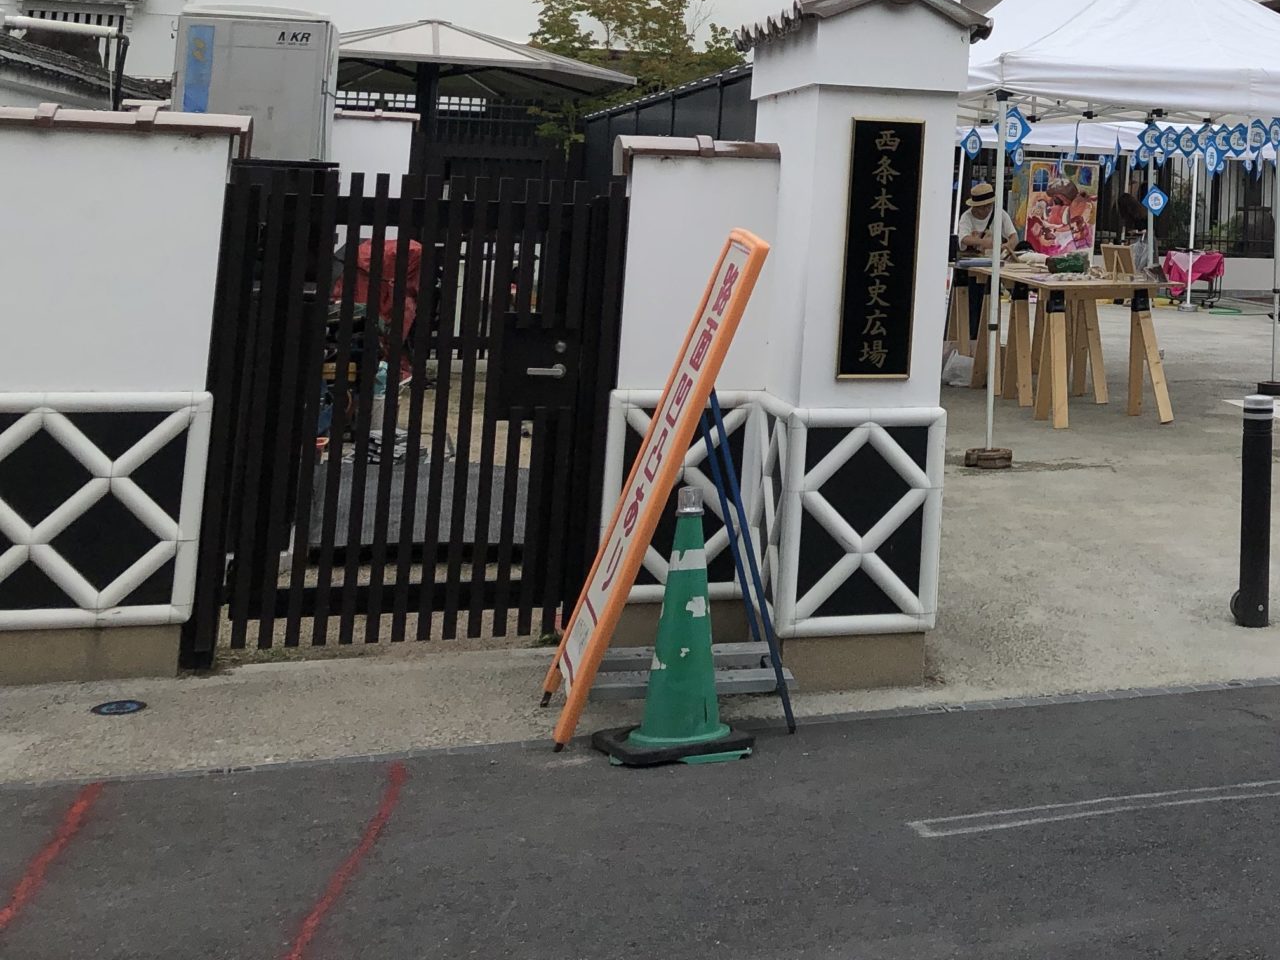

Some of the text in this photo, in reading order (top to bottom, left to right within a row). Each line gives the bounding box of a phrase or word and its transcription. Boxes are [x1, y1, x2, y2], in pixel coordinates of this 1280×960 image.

[858, 129, 901, 369] 西条本町歴史広場
[601, 262, 740, 592] 路面凹凸あり
